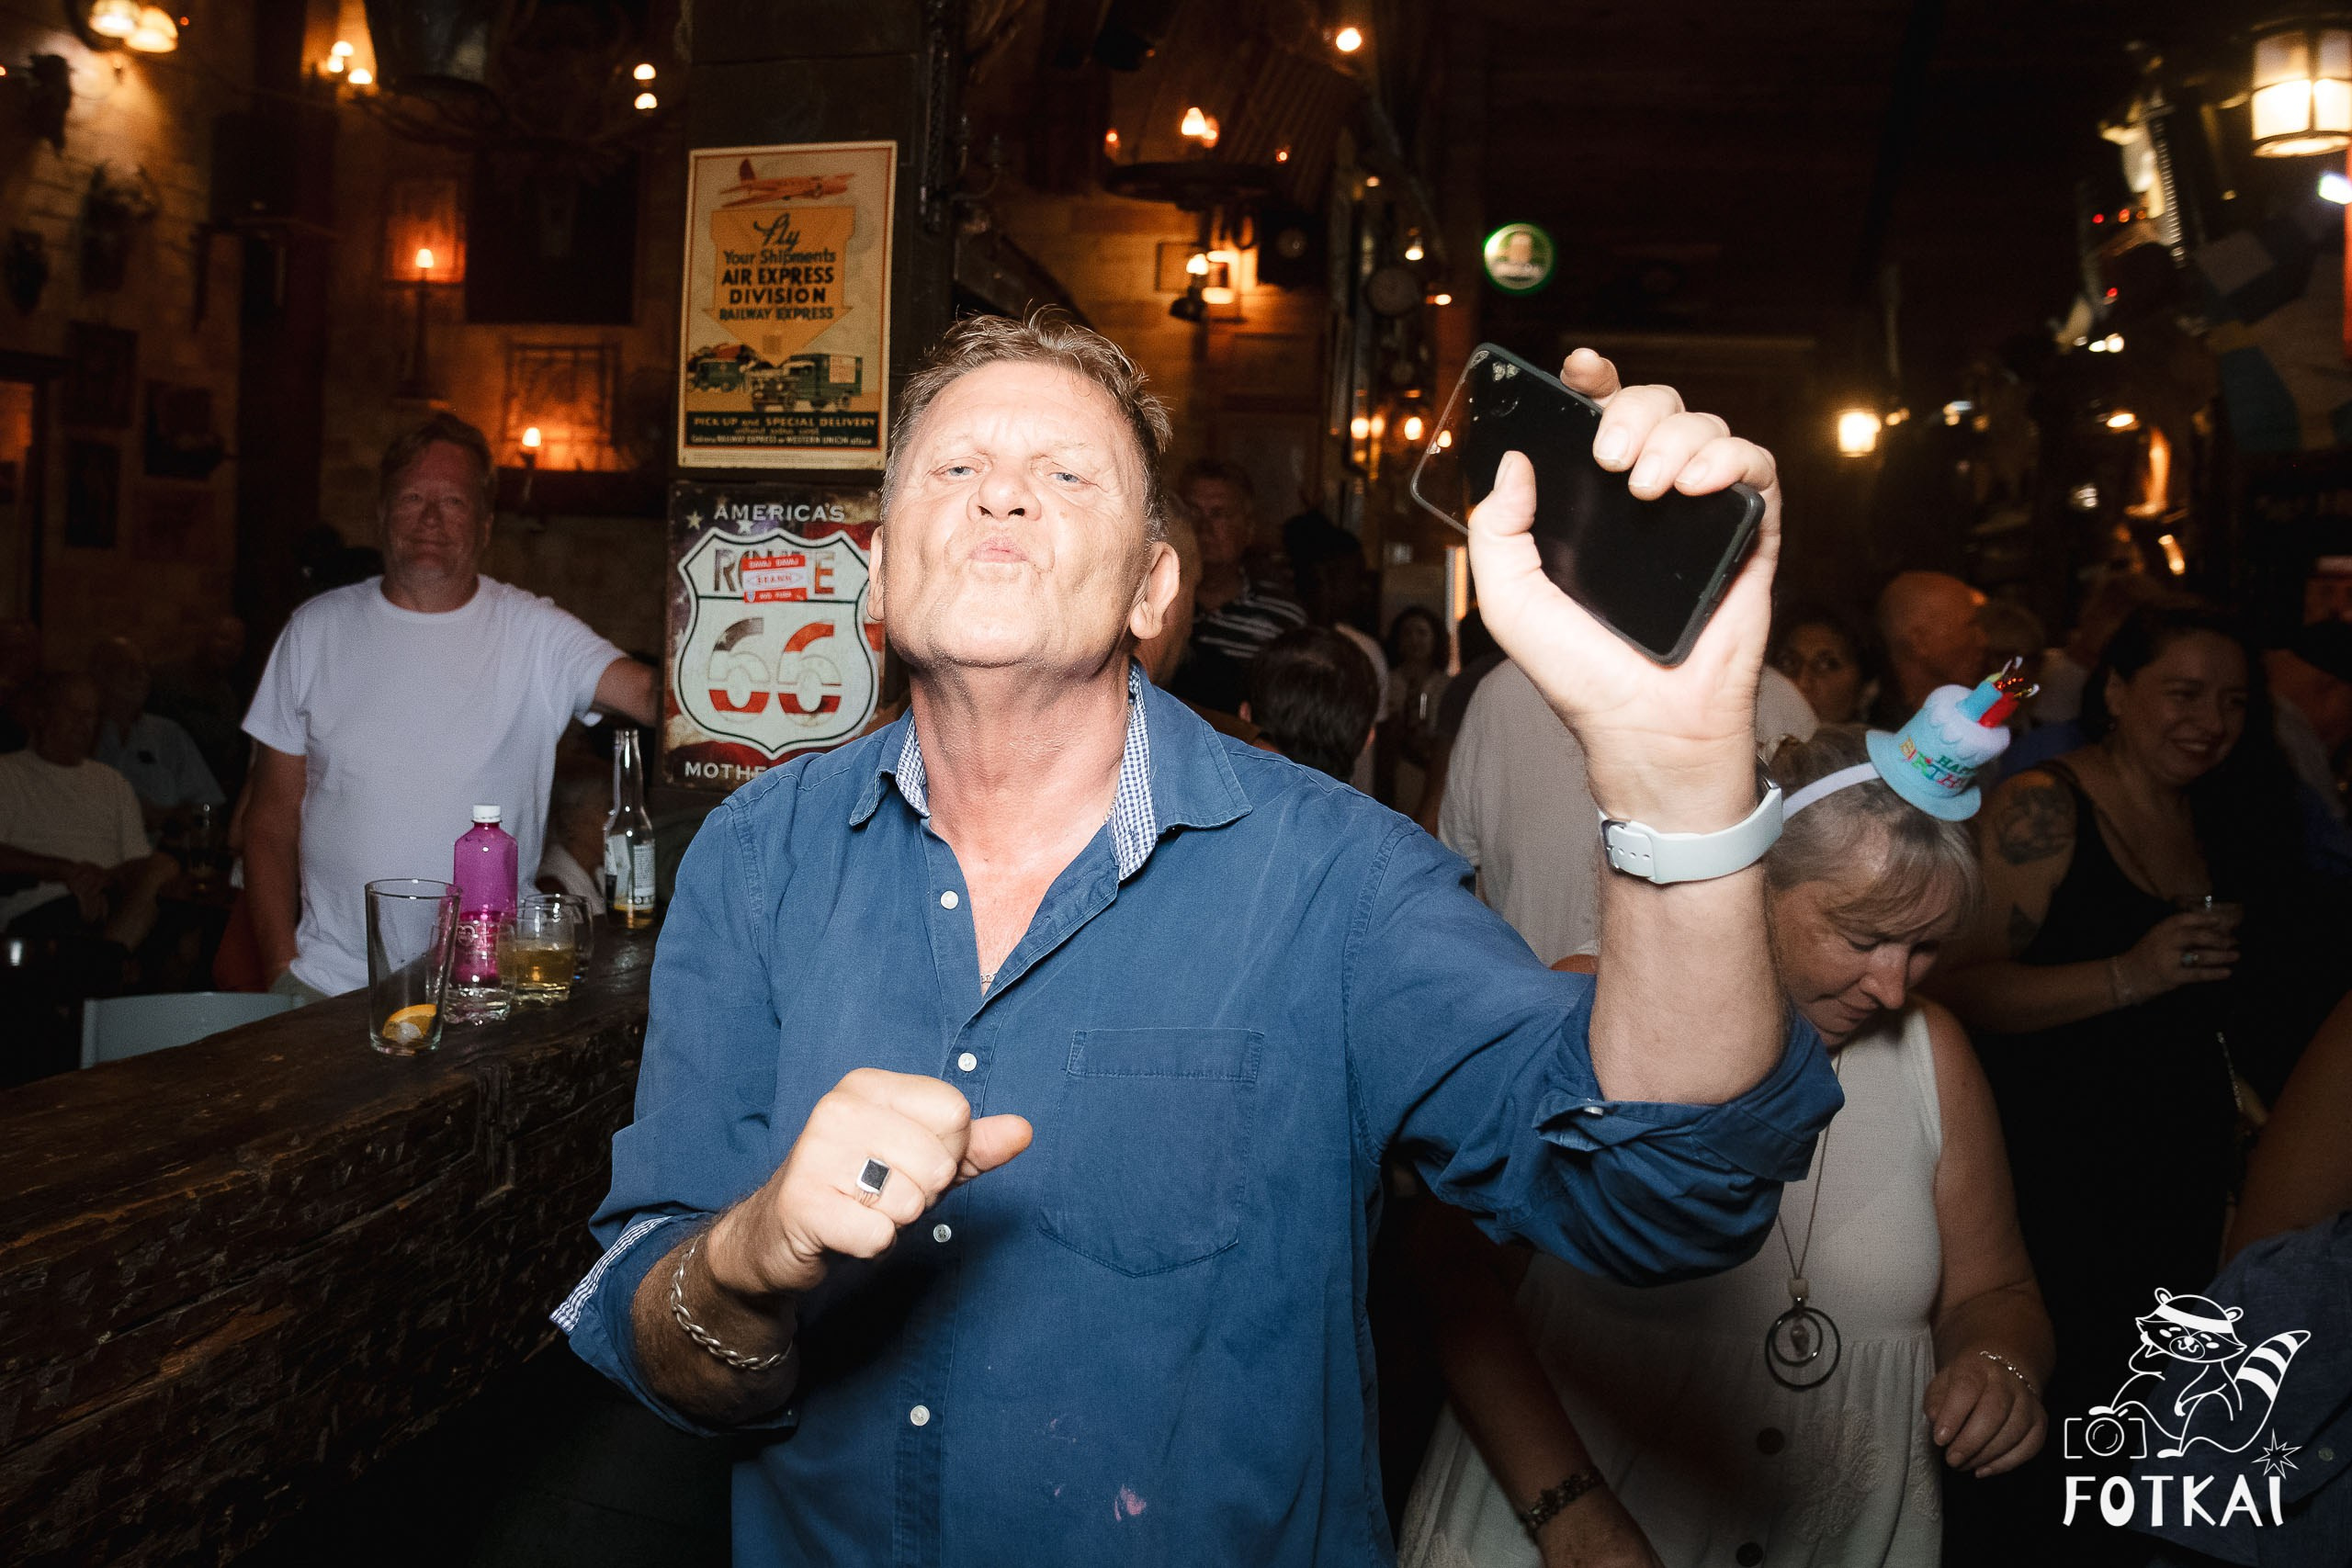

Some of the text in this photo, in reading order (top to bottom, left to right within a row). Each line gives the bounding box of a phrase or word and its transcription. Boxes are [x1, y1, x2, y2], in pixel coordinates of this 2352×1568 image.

[753, 212, 800, 253] Fly
[723, 246, 836, 265] Your Shipments
[721, 265, 834, 287] AIR EXPRESS
[729, 288, 826, 305] DIVISION
[719, 306, 834, 321] RAILWAY EXPRESS
[766, 417, 814, 427] SPECIAL
[820, 417, 876, 427] DELIVERY
[713, 503, 845, 522] AMERICA'S
[708, 617, 842, 726] 66
